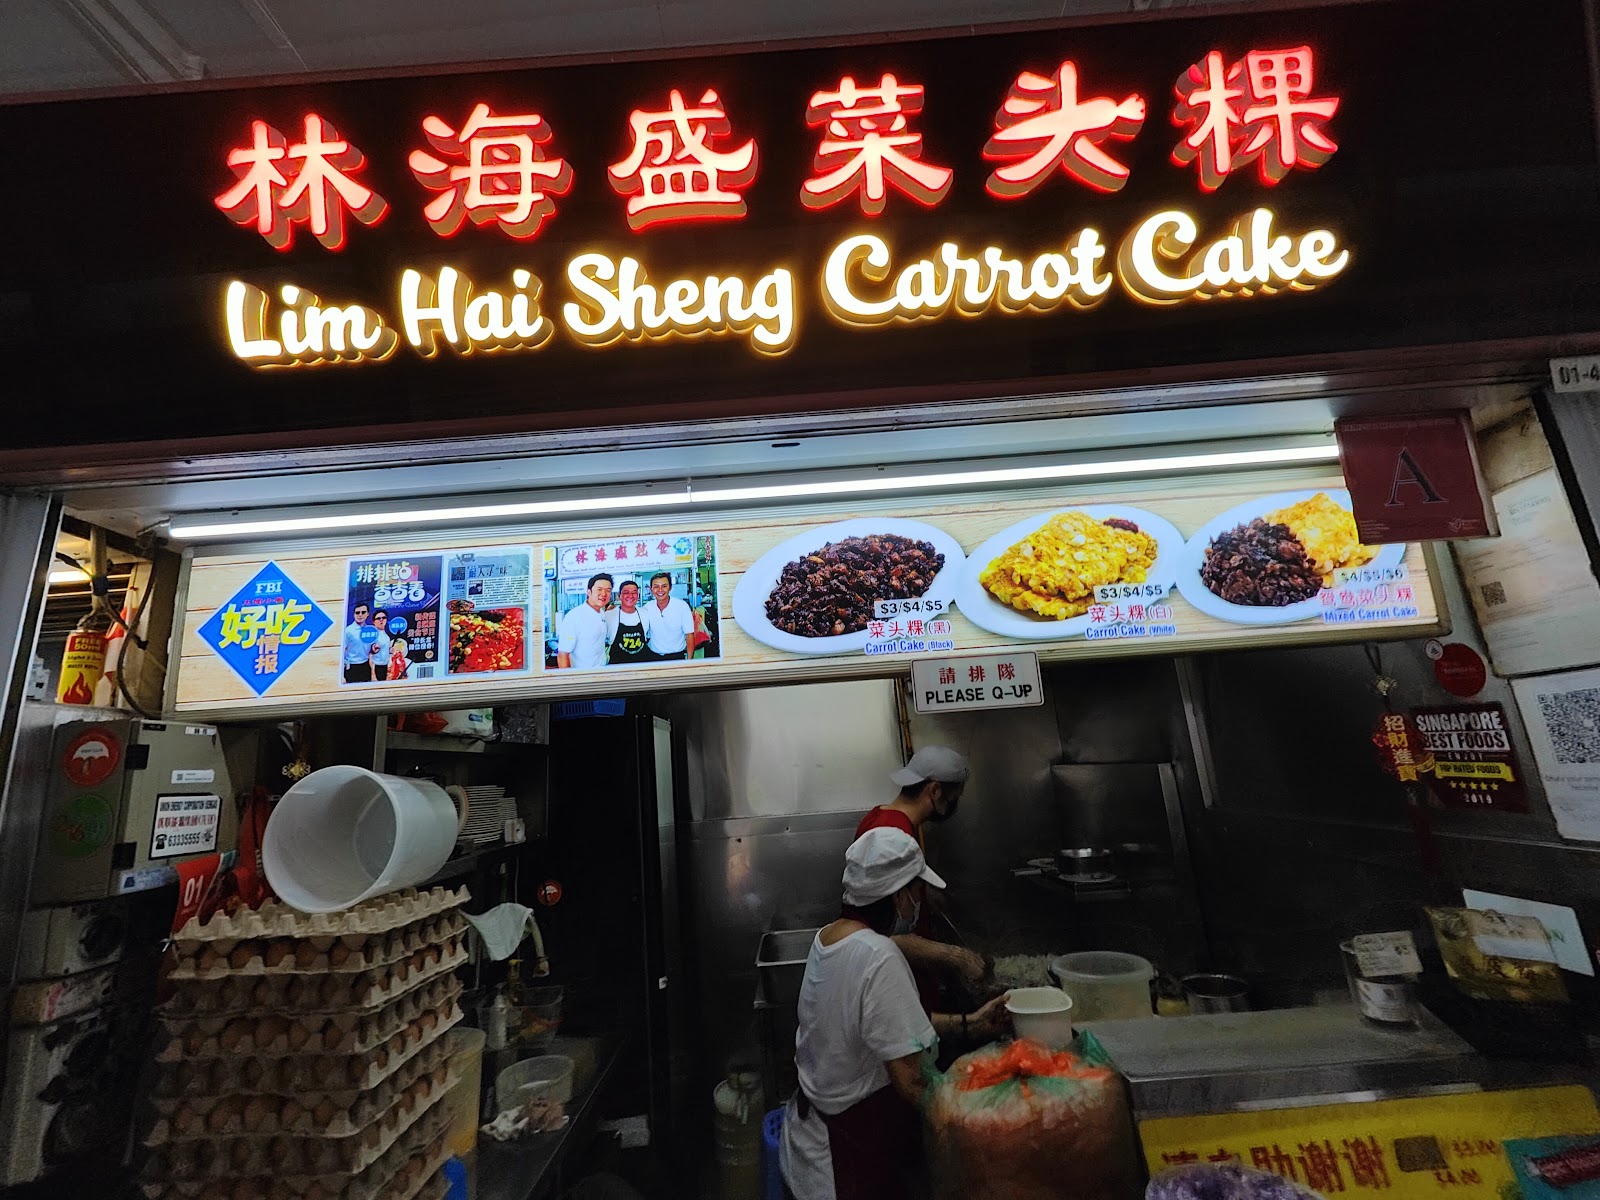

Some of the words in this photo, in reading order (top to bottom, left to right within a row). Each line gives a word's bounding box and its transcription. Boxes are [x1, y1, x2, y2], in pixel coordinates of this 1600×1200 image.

[215, 46, 1339, 243] 林海盛菜头粿
[224, 279, 388, 362] Lim
[400, 265, 547, 348] Hai
[562, 252, 793, 348] Sheng
[823, 227, 1113, 318] Carrot
[1128, 208, 1350, 296] Cake
[1384, 446, 1449, 508] A
[255, 581, 283, 594] FBI
[1100, 584, 1163, 599] $3/$4/$5
[880, 600, 943, 614] $3/$4/$5
[1089, 604, 1173, 623] 菜头粿(白)
[1324, 609, 1356, 622] Mixed
[1358, 608, 1390, 620] Carrot
[1393, 605, 1418, 618] Cake
[218, 599, 313, 649] 好吃
[868, 619, 952, 639] 菜头粿(黑)
[1086, 625, 1118, 638] Carrot
[1121, 624, 1146, 636] Cake
[1149, 624, 1176, 635] (White)
[254, 634, 281, 675] 情报
[865, 641, 898, 654] Carrot
[900, 640, 925, 651] Cake
[928, 639, 954, 650] (Black)
[938, 662, 1016, 685] 請排隊
[925, 687, 985, 704] PLEASE
[992, 684, 1033, 700] Q-UP
[1415, 711, 1503, 732] SINGAPORE
[1424, 732, 1455, 749] BEST
[1457, 731, 1506, 749] FOODS
[1447, 751, 1484, 761] ENJOY
[1440, 764, 1452, 774] TOP
[1477, 765, 1502, 775] FOODS
